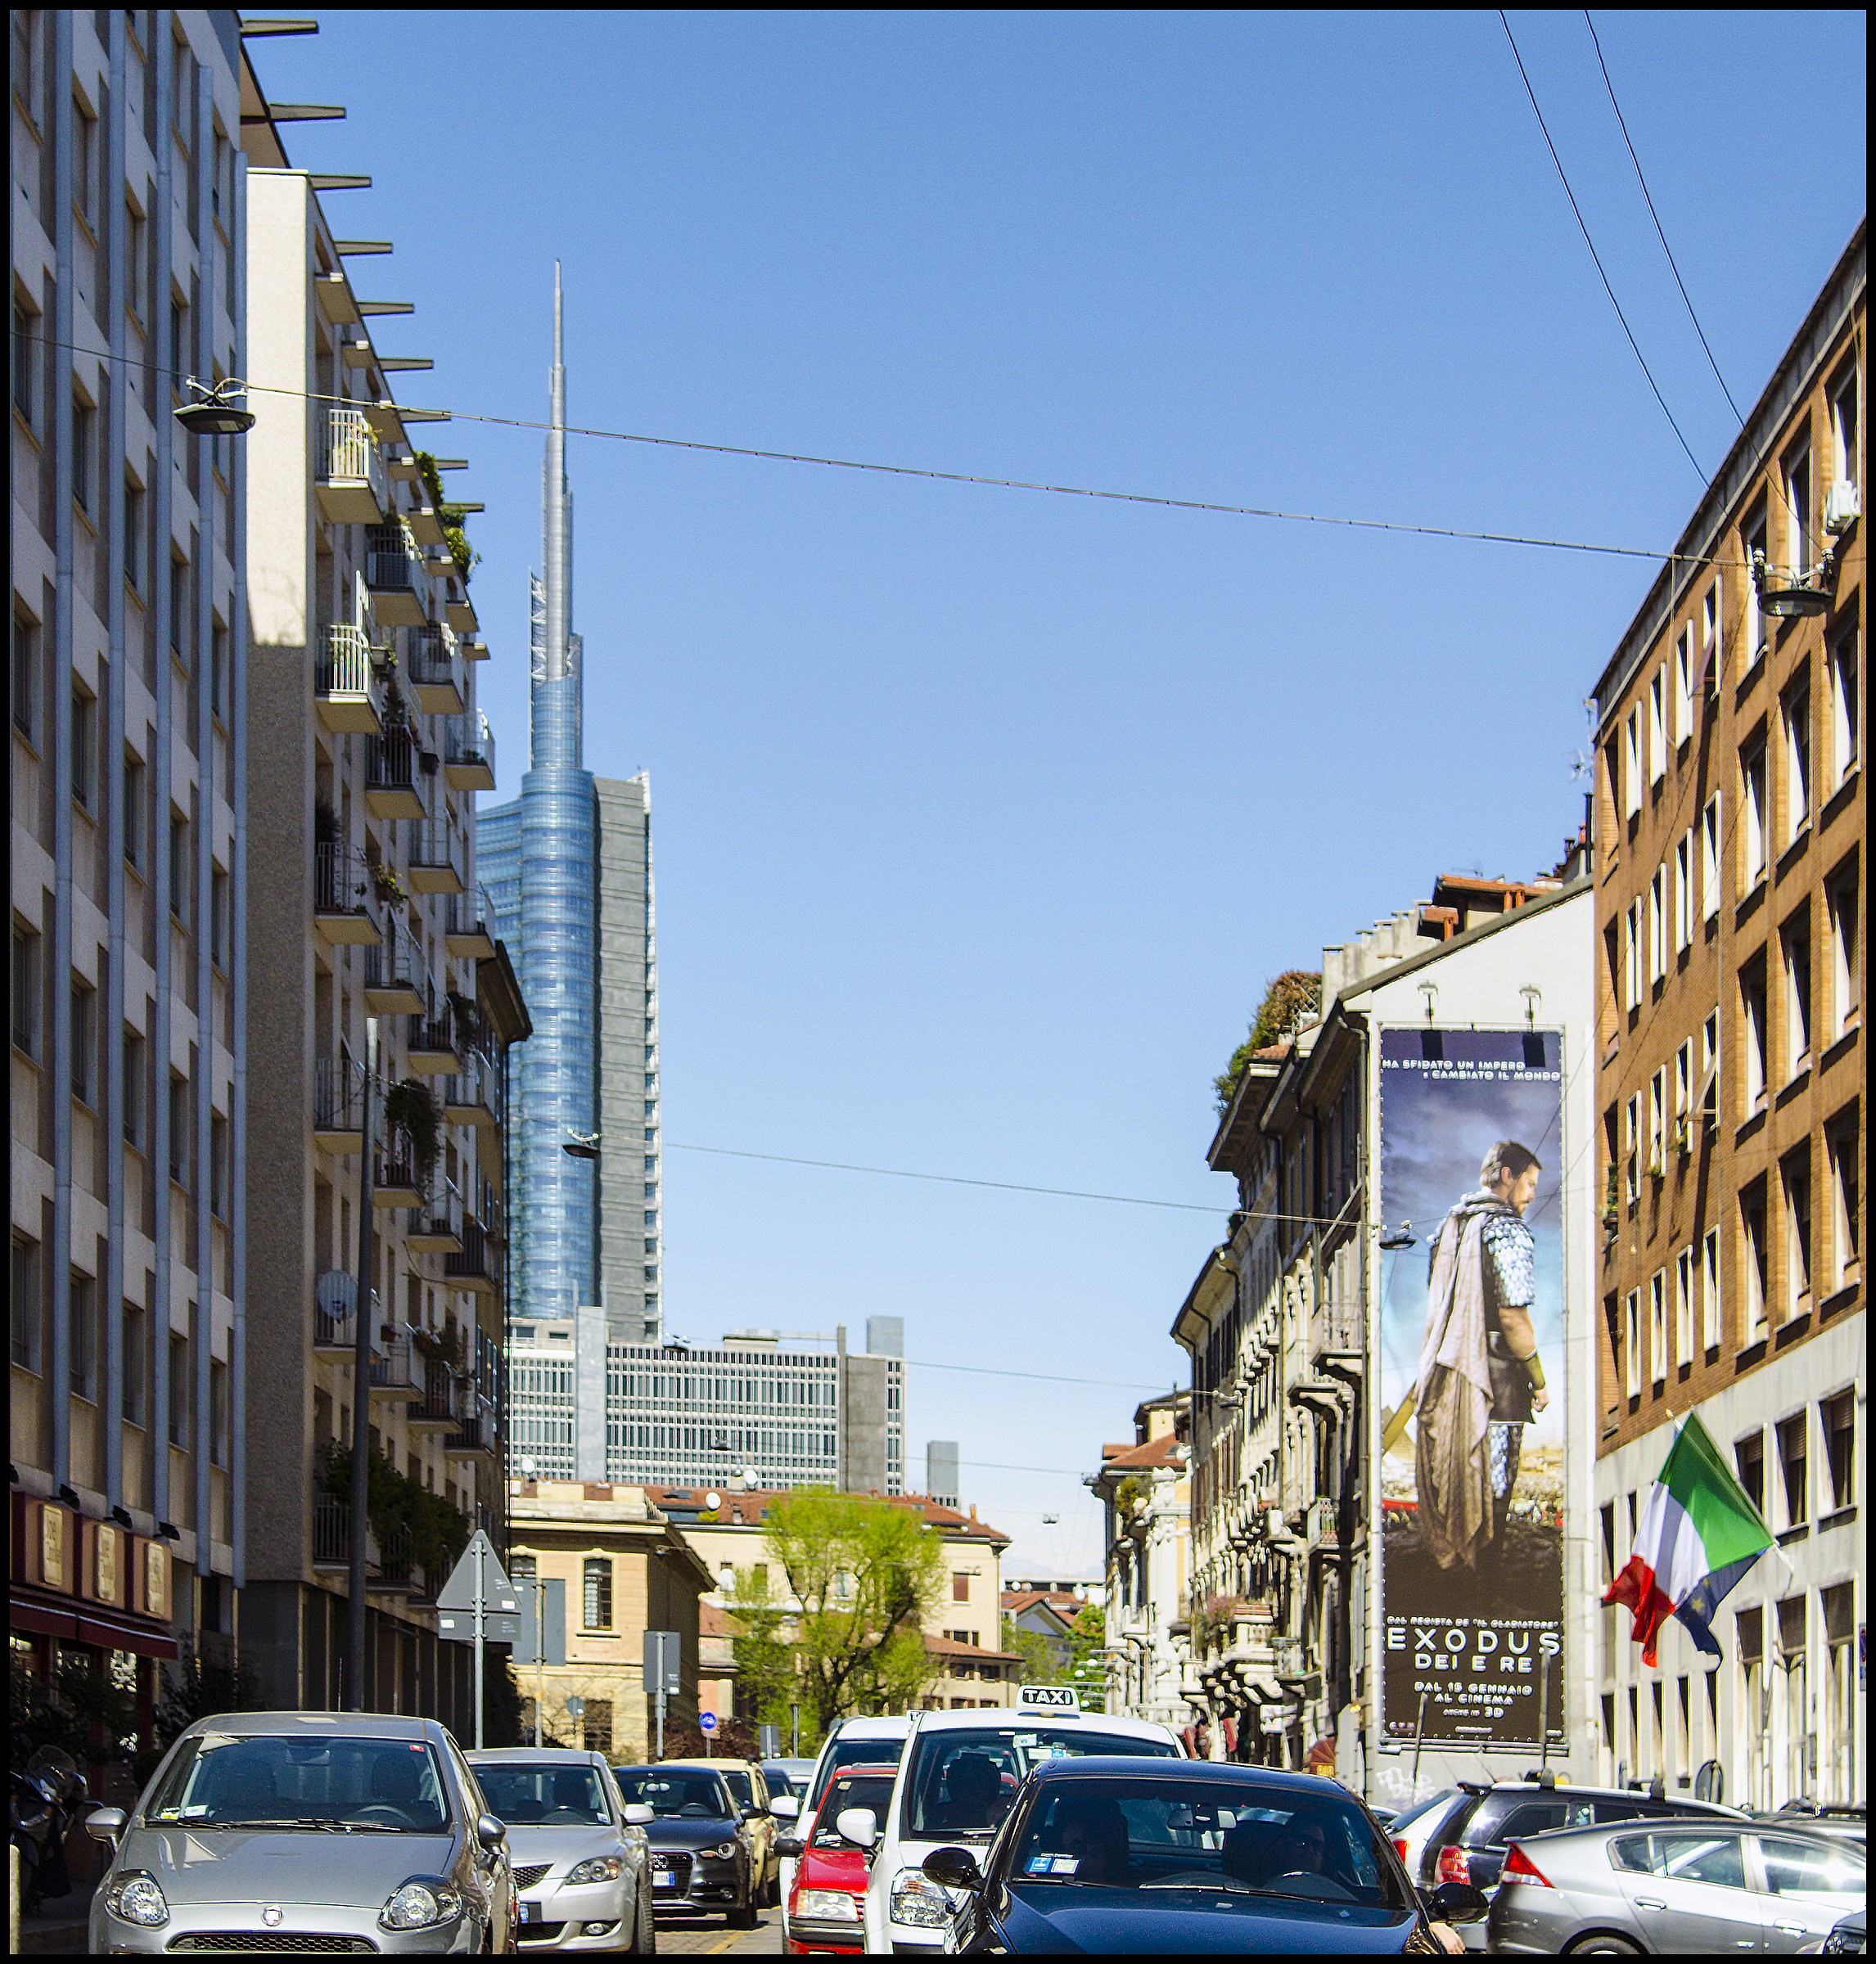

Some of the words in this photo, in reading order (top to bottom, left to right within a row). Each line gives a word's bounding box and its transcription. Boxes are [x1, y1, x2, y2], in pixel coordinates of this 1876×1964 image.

[1382, 1060, 1399, 1069] HA
[1403, 1060, 1453, 1070] SFIDATO
[1457, 1061, 1474, 1070] UN
[1478, 1061, 1526, 1071] IMPERO
[1432, 1070, 1494, 1080] CAMBIATO
[1498, 1071, 1509, 1080] IL
[1513, 1072, 1561, 1081] MONDO
[1387, 1616, 1407, 1625] DAL
[1411, 1617, 1452, 1626] REGISTA
[1455, 1619, 1469, 1627] DE
[1387, 1627, 1560, 1655] EXODUS
[1414, 1653, 1458, 1671] DEI
[1472, 1655, 1486, 1672] E
[1500, 1656, 1533, 1673] RE
[1414, 1681, 1442, 1692] DAL
[1448, 1682, 1463, 1693] 15
[1468, 1683, 1533, 1696] GENNAIO
[1024, 1690, 1071, 1705] TAXI
[1434, 1693, 1453, 1704] AL
[1458, 1694, 1513, 1705] CINEMA
[1484, 1706, 1504, 1718] 3D
